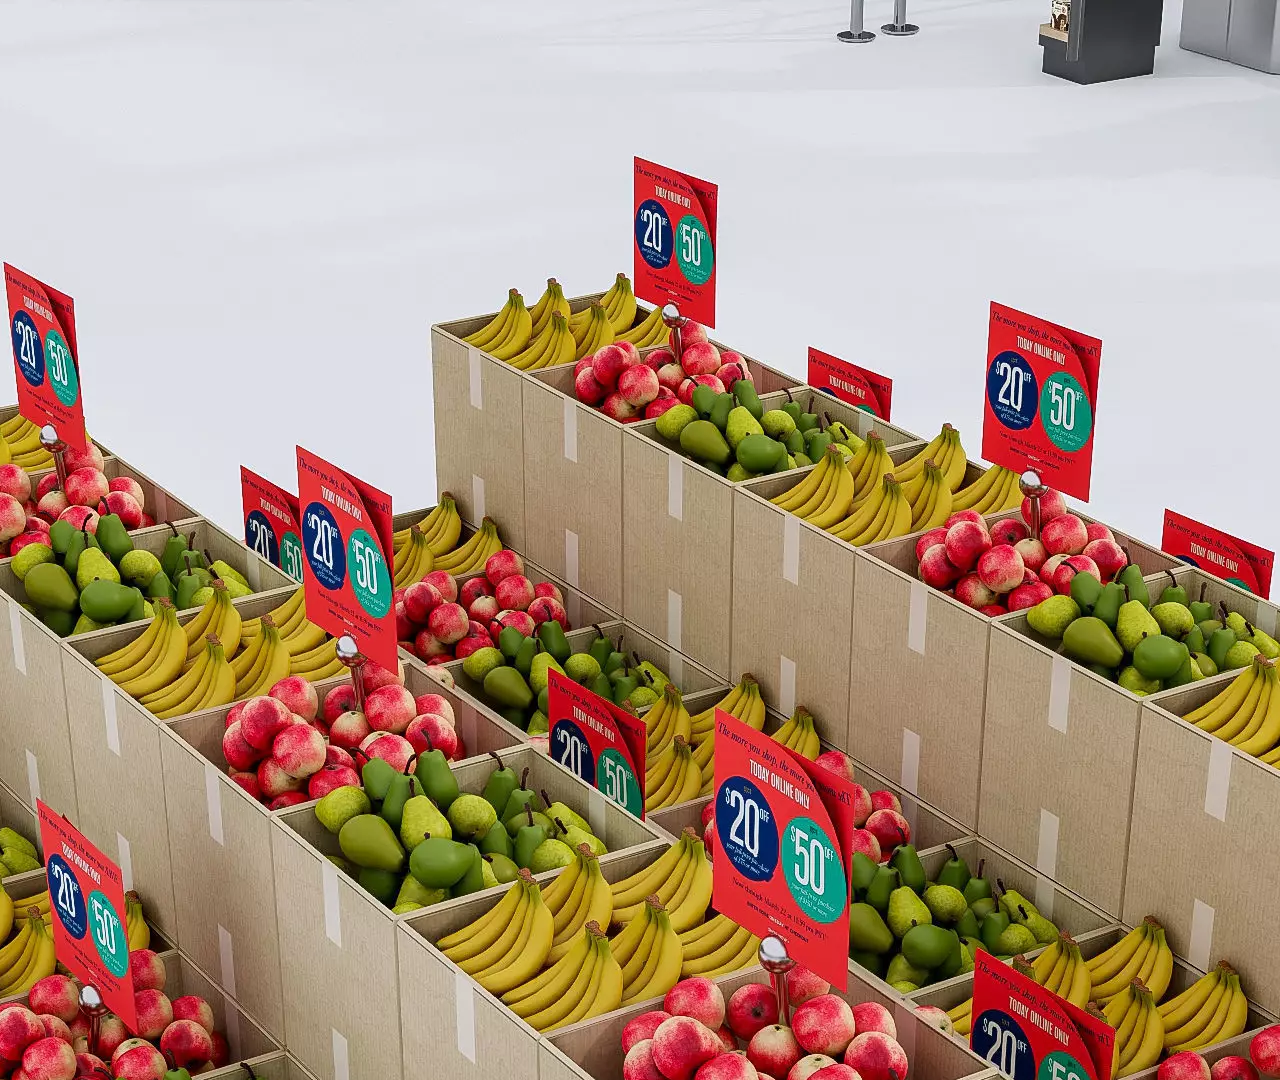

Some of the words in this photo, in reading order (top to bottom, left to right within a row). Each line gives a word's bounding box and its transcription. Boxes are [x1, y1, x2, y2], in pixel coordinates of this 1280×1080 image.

[750, 759, 769, 783] TODAY
[771, 773, 793, 799] ONLINE
[795, 788, 809, 809] ONLY
